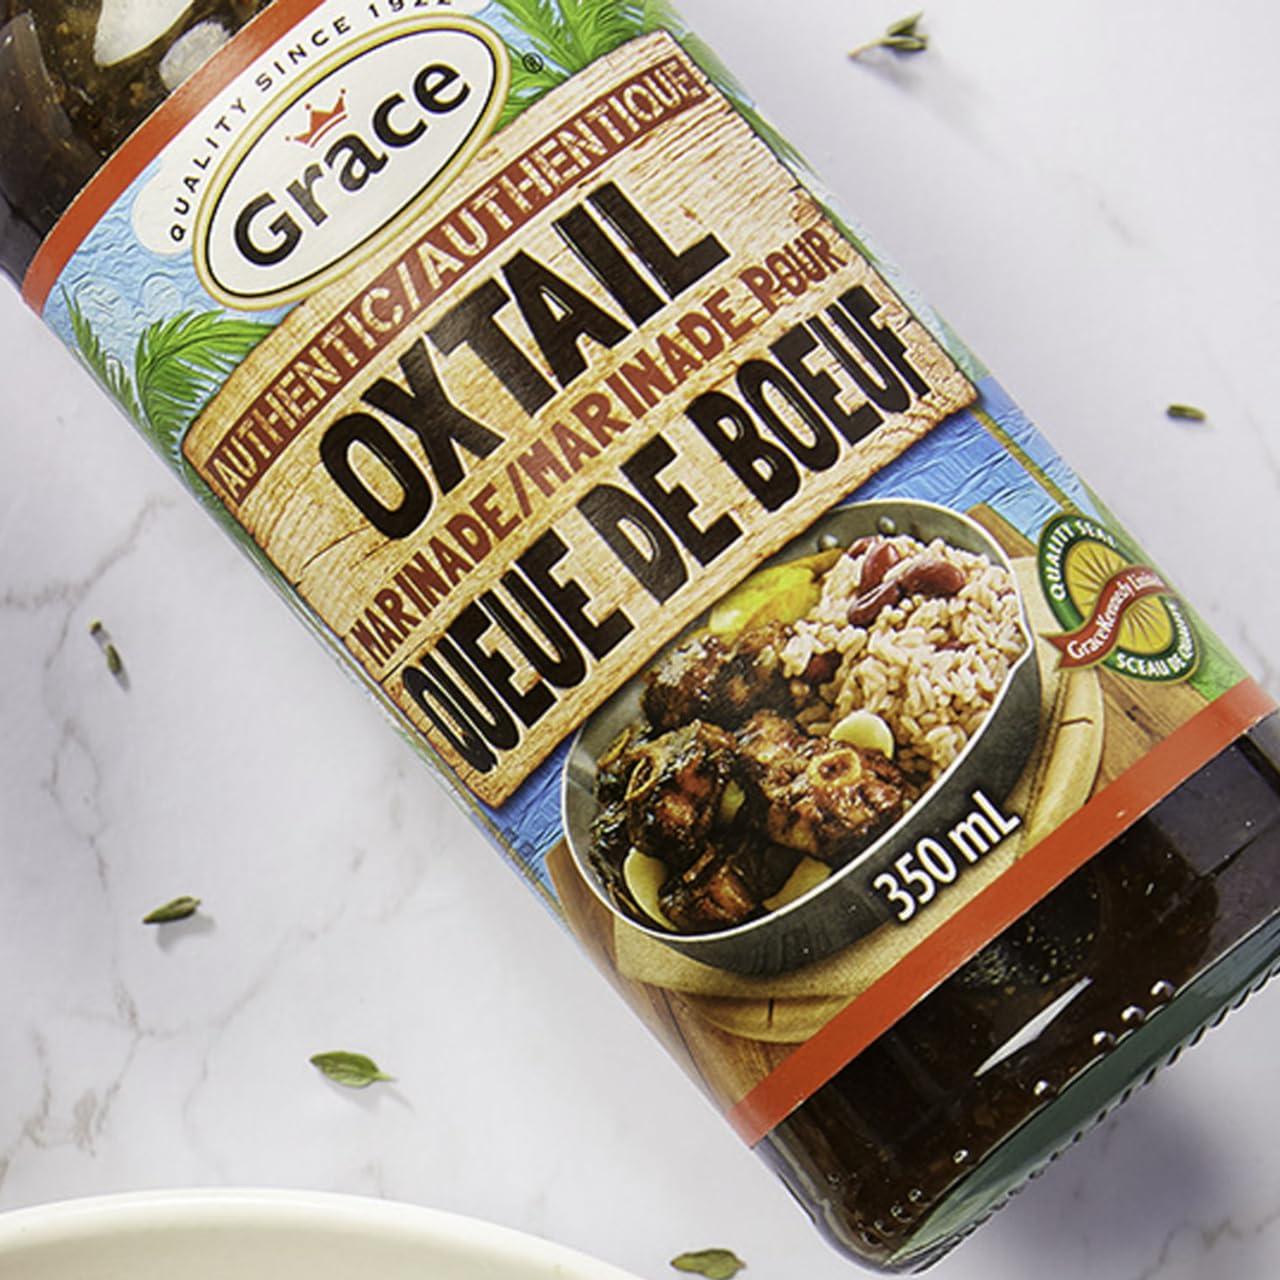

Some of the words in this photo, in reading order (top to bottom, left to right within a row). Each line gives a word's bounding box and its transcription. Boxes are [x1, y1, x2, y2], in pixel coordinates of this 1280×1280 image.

[170, 97, 248, 242] QUALITY
[255, 16, 350, 91] SINCE
[234, 64, 471, 266] Grace
[213, 63, 705, 499] AUTHENTIC/AUTHENTIQUE
[319, 181, 730, 539] OXTAIL
[349, 285, 756, 667] MARINADE/MARINADE
[739, 228, 848, 314] POUR
[401, 525, 635, 773] QUEUE
[578, 435, 744, 605] DE
[683, 284, 930, 513] BOEUF
[1045, 521, 1075, 601] QUALITY
[872, 837, 958, 921] 350
[947, 790, 1021, 863] mL
